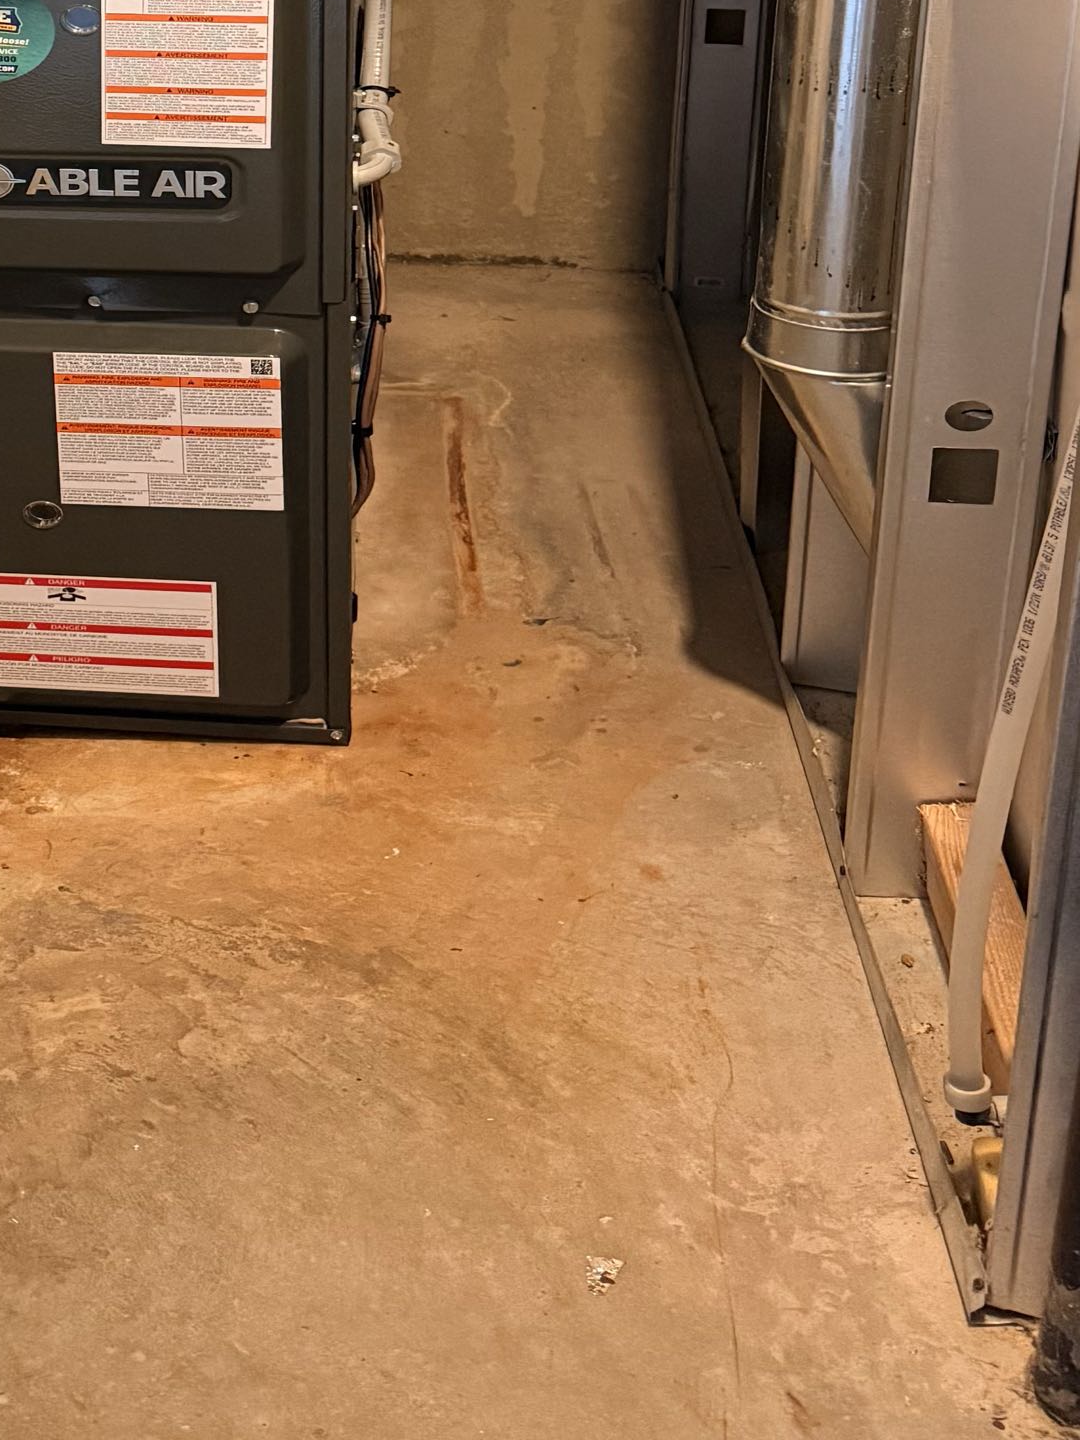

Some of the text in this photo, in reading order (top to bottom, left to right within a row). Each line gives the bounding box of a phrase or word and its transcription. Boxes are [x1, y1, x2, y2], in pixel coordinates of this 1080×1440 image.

[26, 168, 226, 199] ABLE AIR
[48, 579, 85, 587] DANGER
[50, 624, 87, 632] DANGER
[52, 655, 91, 663] PELIGRO
